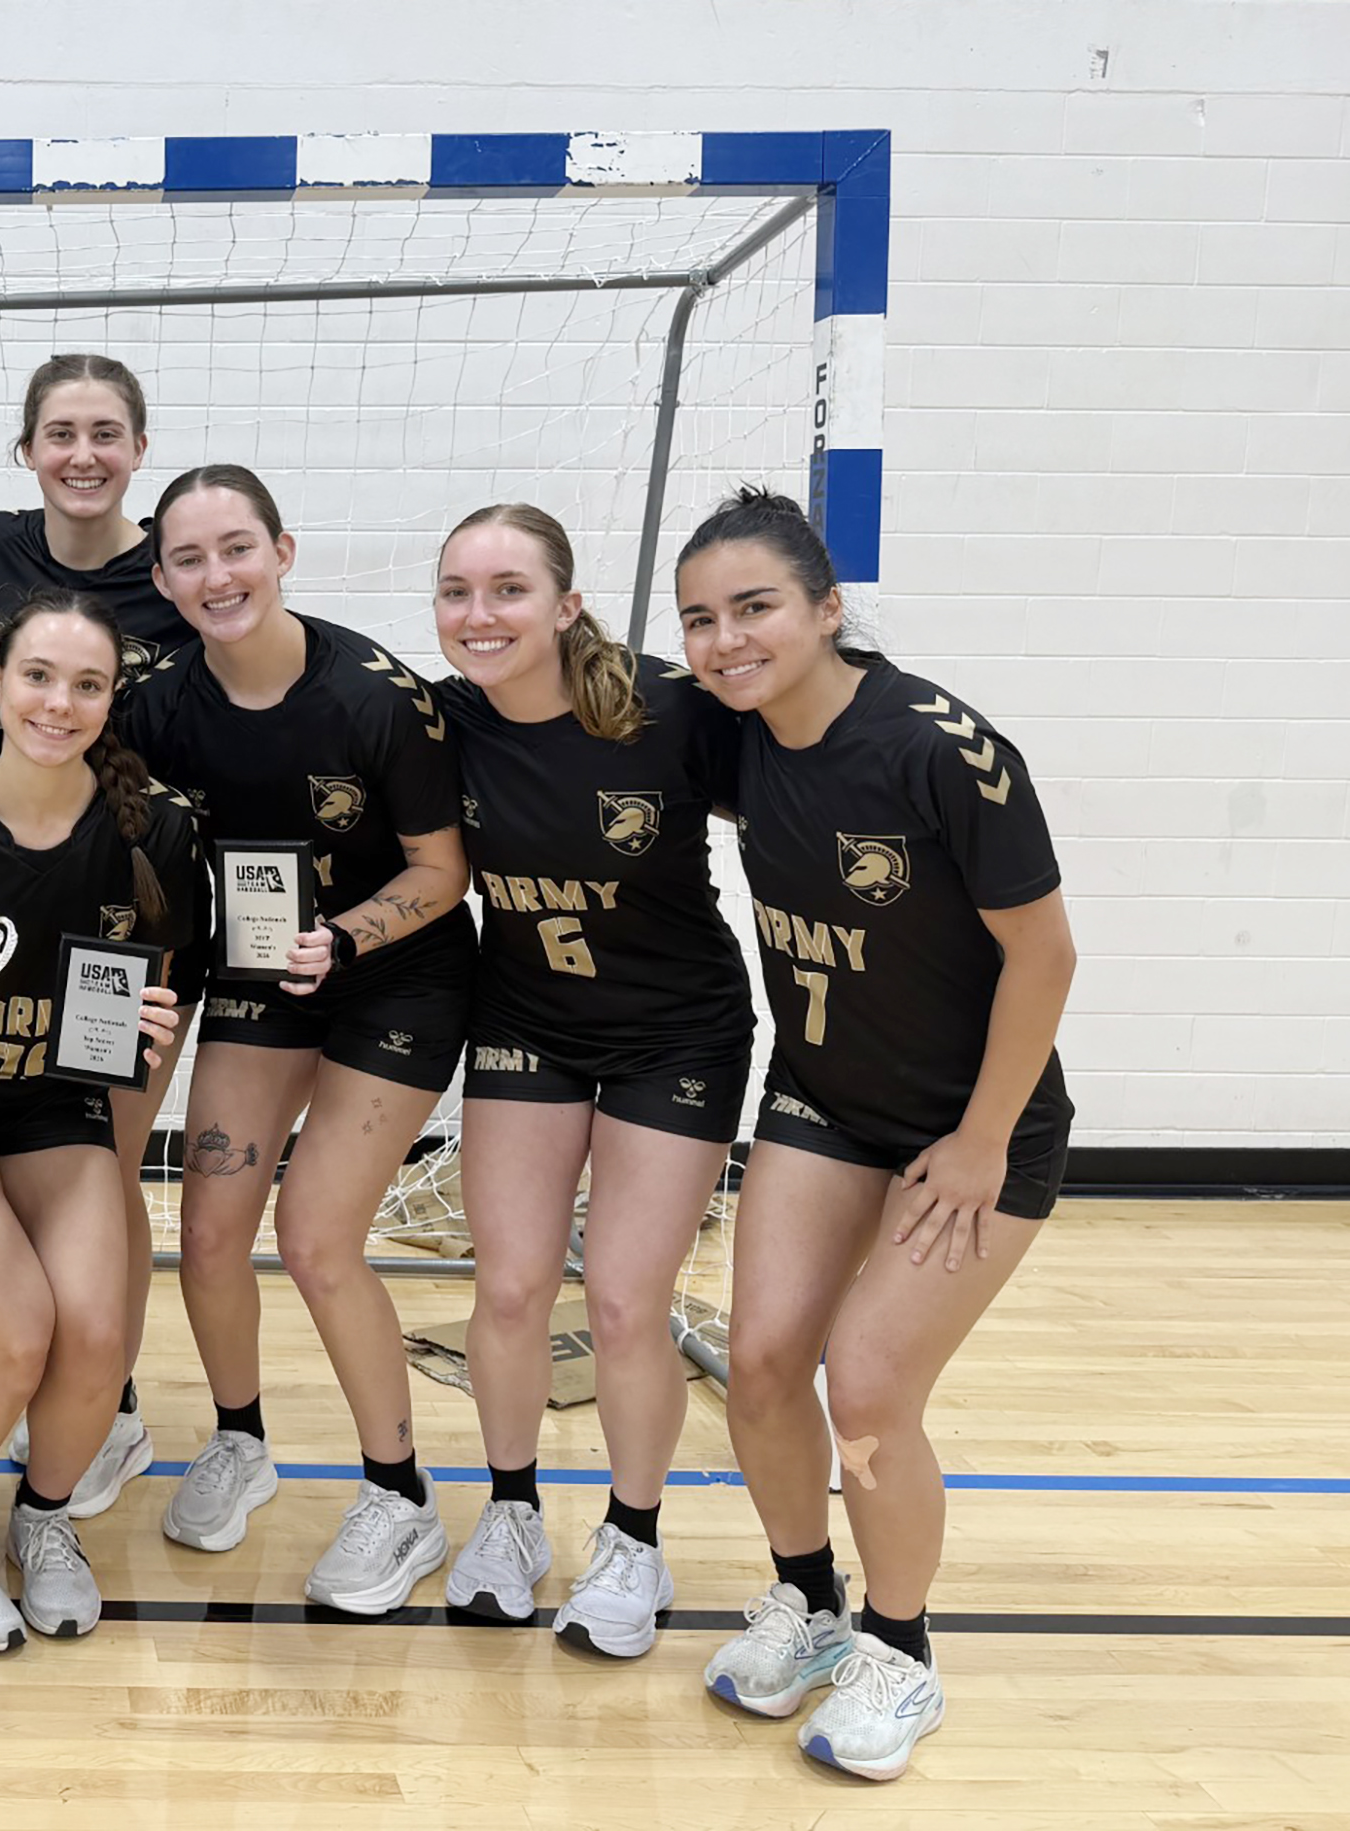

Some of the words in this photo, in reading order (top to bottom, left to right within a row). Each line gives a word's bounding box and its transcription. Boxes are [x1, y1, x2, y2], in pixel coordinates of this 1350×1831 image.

[236, 865, 265, 880] USA
[481, 870, 619, 913] ARMY
[537, 916, 596, 978] 6
[81, 962, 111, 981] USA
[474, 1046, 540, 1073] ARMY
[392, 1527, 419, 1567] HOKA
